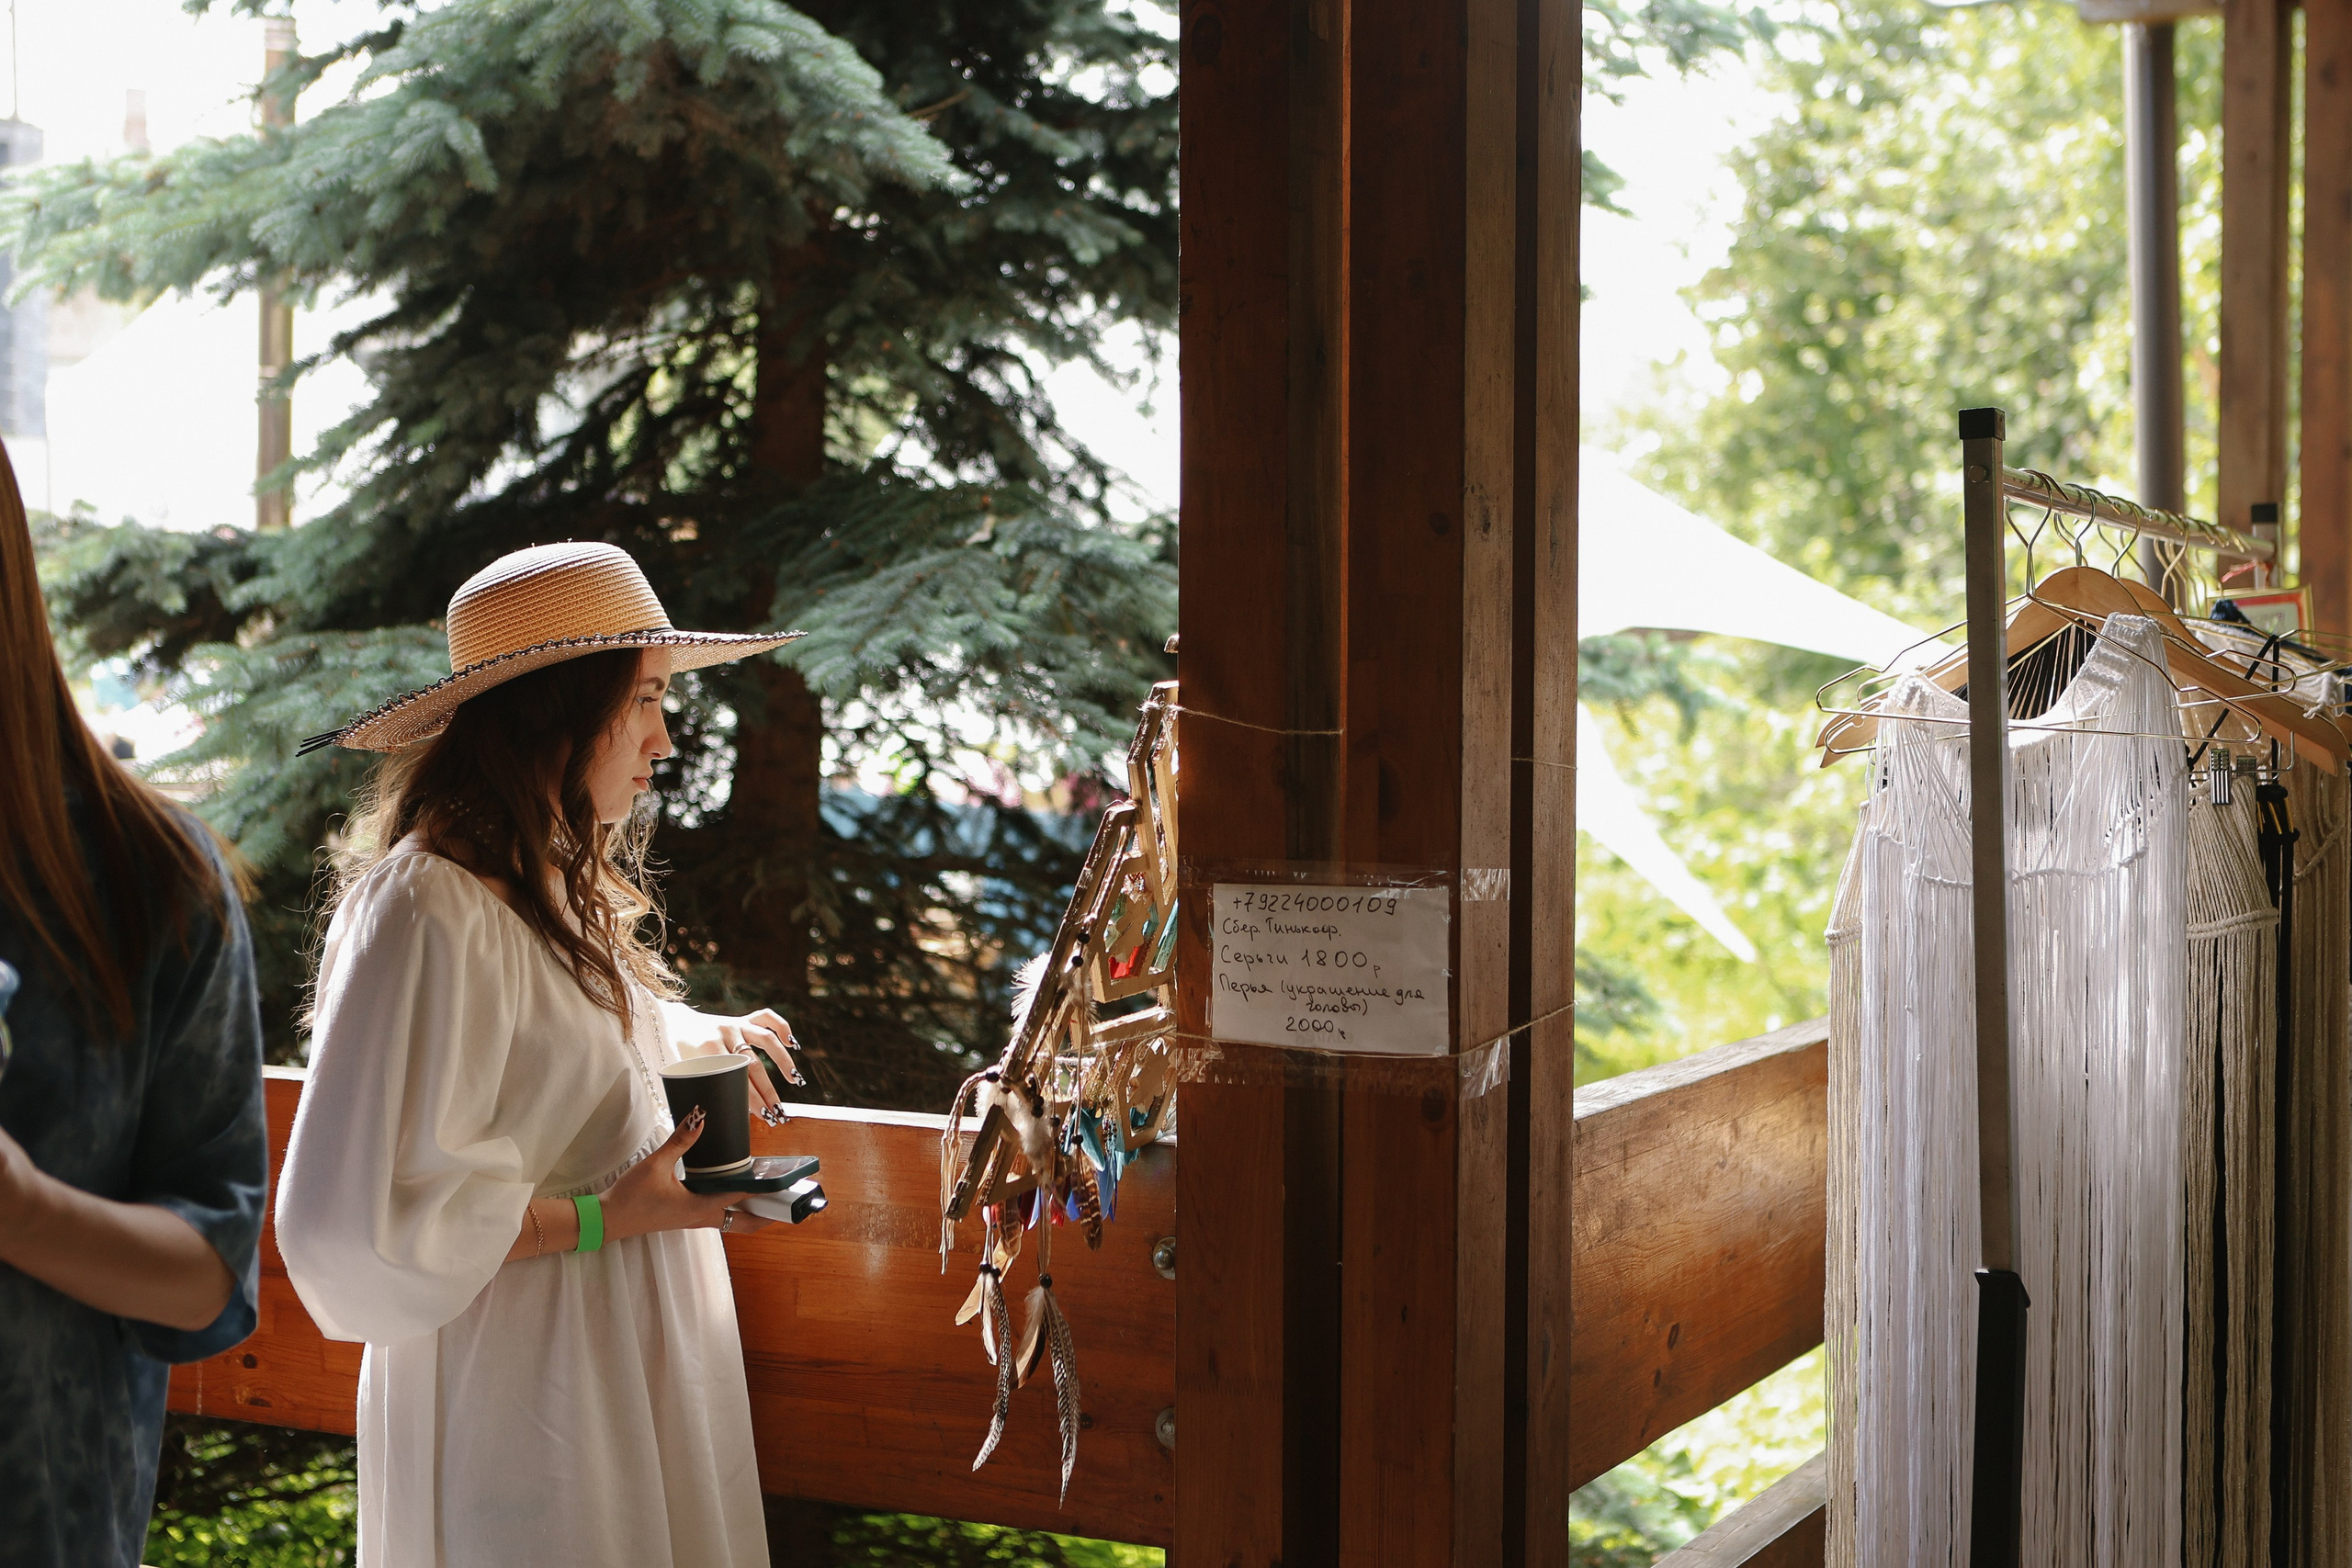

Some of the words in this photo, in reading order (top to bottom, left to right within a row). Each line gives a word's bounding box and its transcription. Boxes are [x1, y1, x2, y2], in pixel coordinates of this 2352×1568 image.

[1233, 892, 1397, 916] +79224000109
[1220, 944, 1288, 972] Серьги
[1219, 973, 1273, 1002] Перья
[1281, 980, 1391, 1003] (украшение
[1395, 988, 1426, 1006] для
[1306, 996, 1368, 1016] головы)
